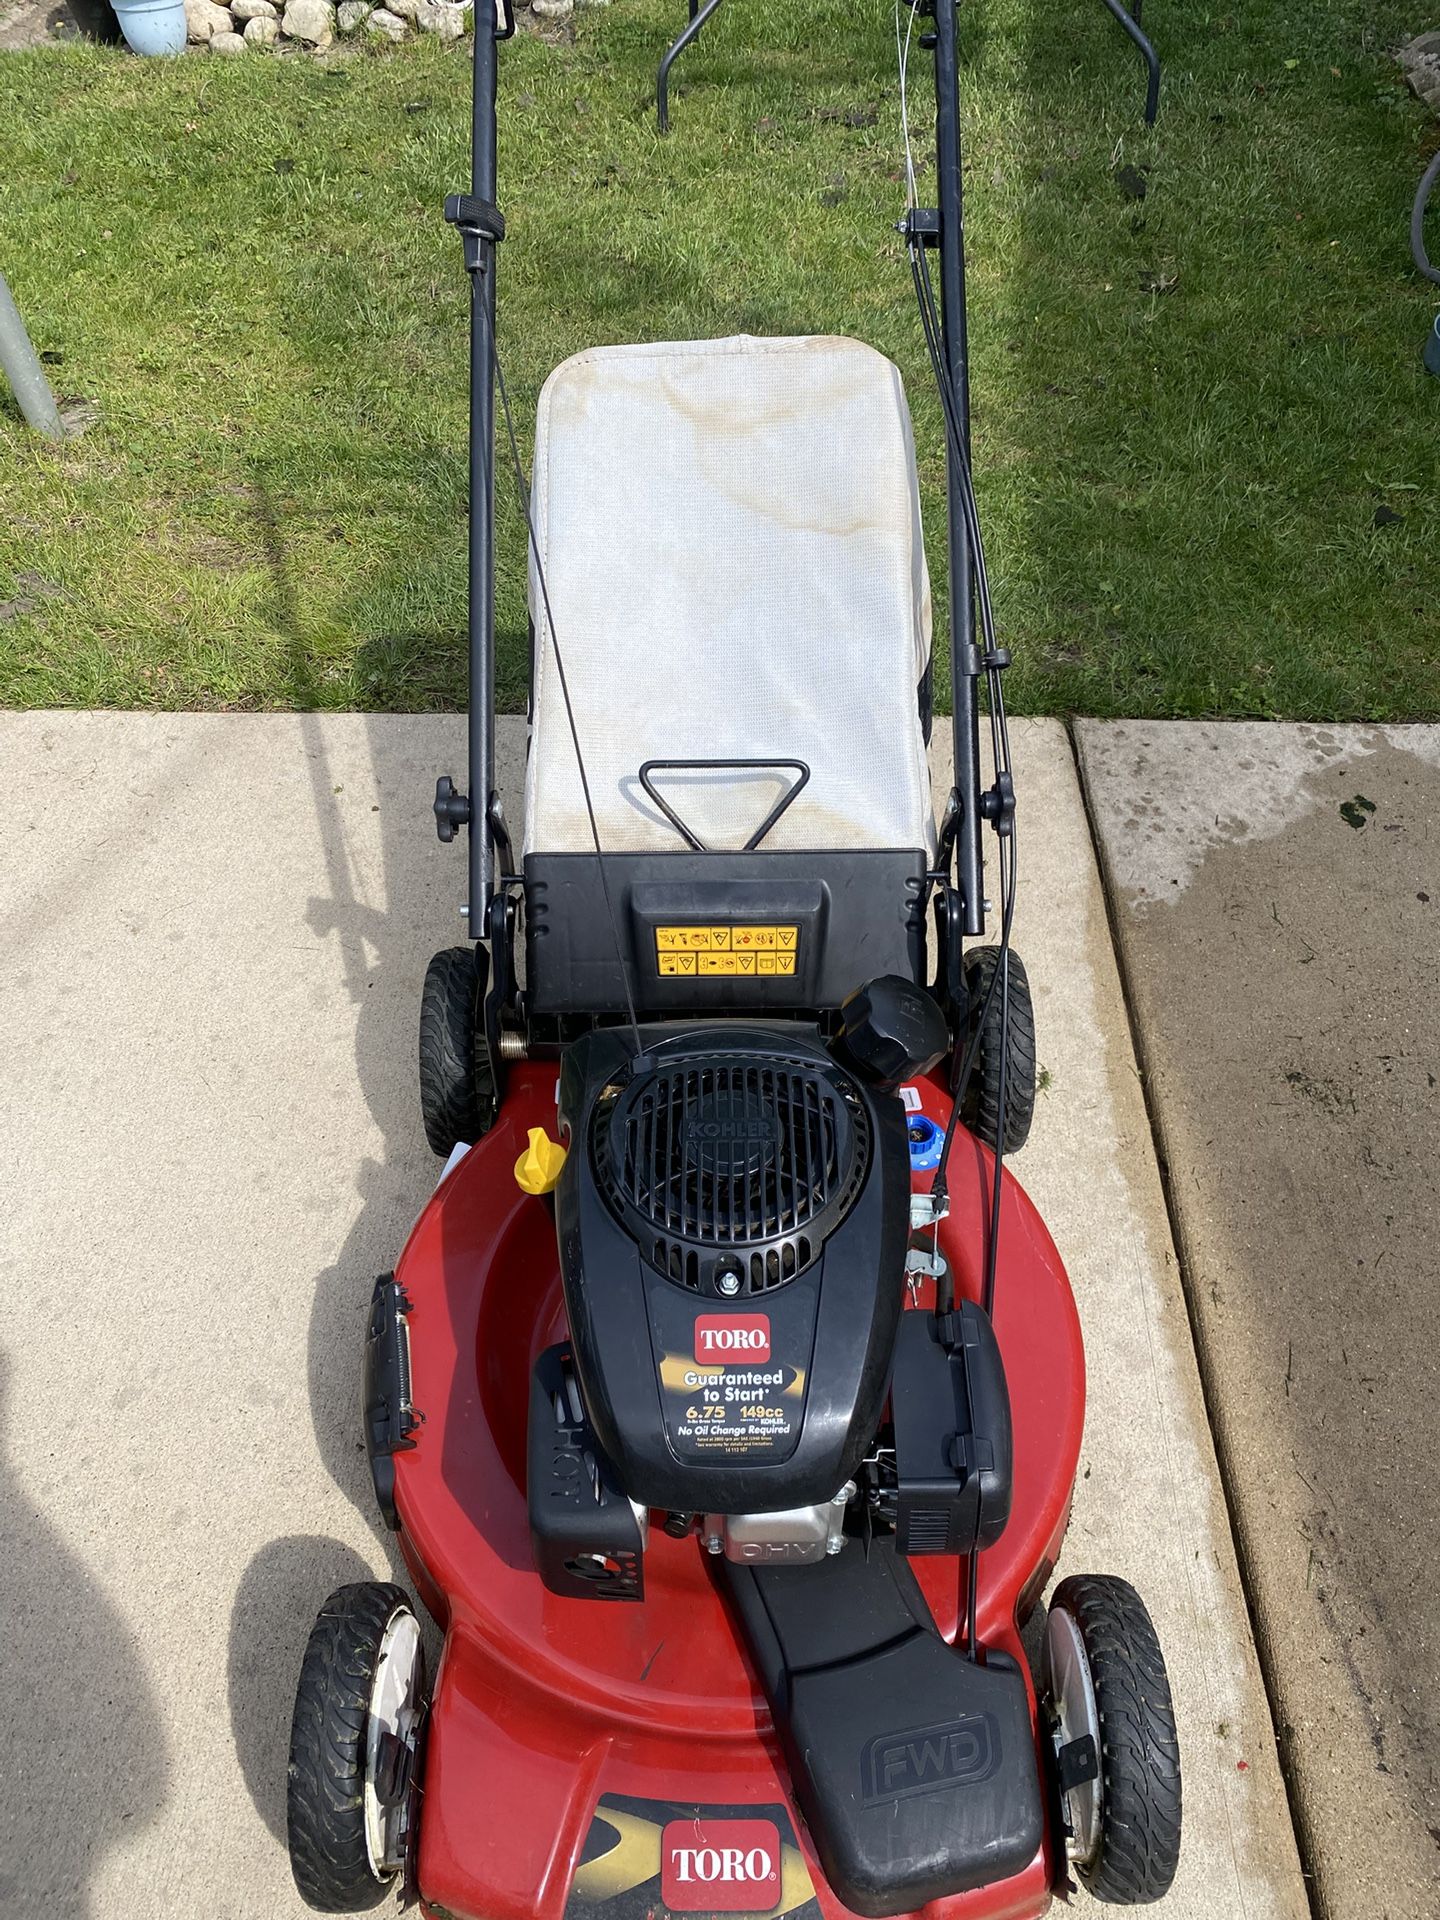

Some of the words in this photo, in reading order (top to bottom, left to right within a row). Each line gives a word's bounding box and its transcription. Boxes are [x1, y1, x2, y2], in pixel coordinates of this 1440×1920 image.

[688, 1121, 772, 1137] KOHLER
[700, 1329, 767, 1349] TORO
[684, 1370, 783, 1386] Guaranteed
[703, 1389, 720, 1402] to
[686, 1406, 726, 1419] 6.75
[740, 1406, 784, 1418] 149cc
[678, 1426, 692, 1436] No
[694, 1425, 709, 1435] Oil
[710, 1425, 746, 1437] Change
[748, 1424, 791, 1437] Required
[741, 1543, 816, 1557] OHV
[882, 1730, 982, 1789] FWD
[671, 1847, 773, 1882] TORO
